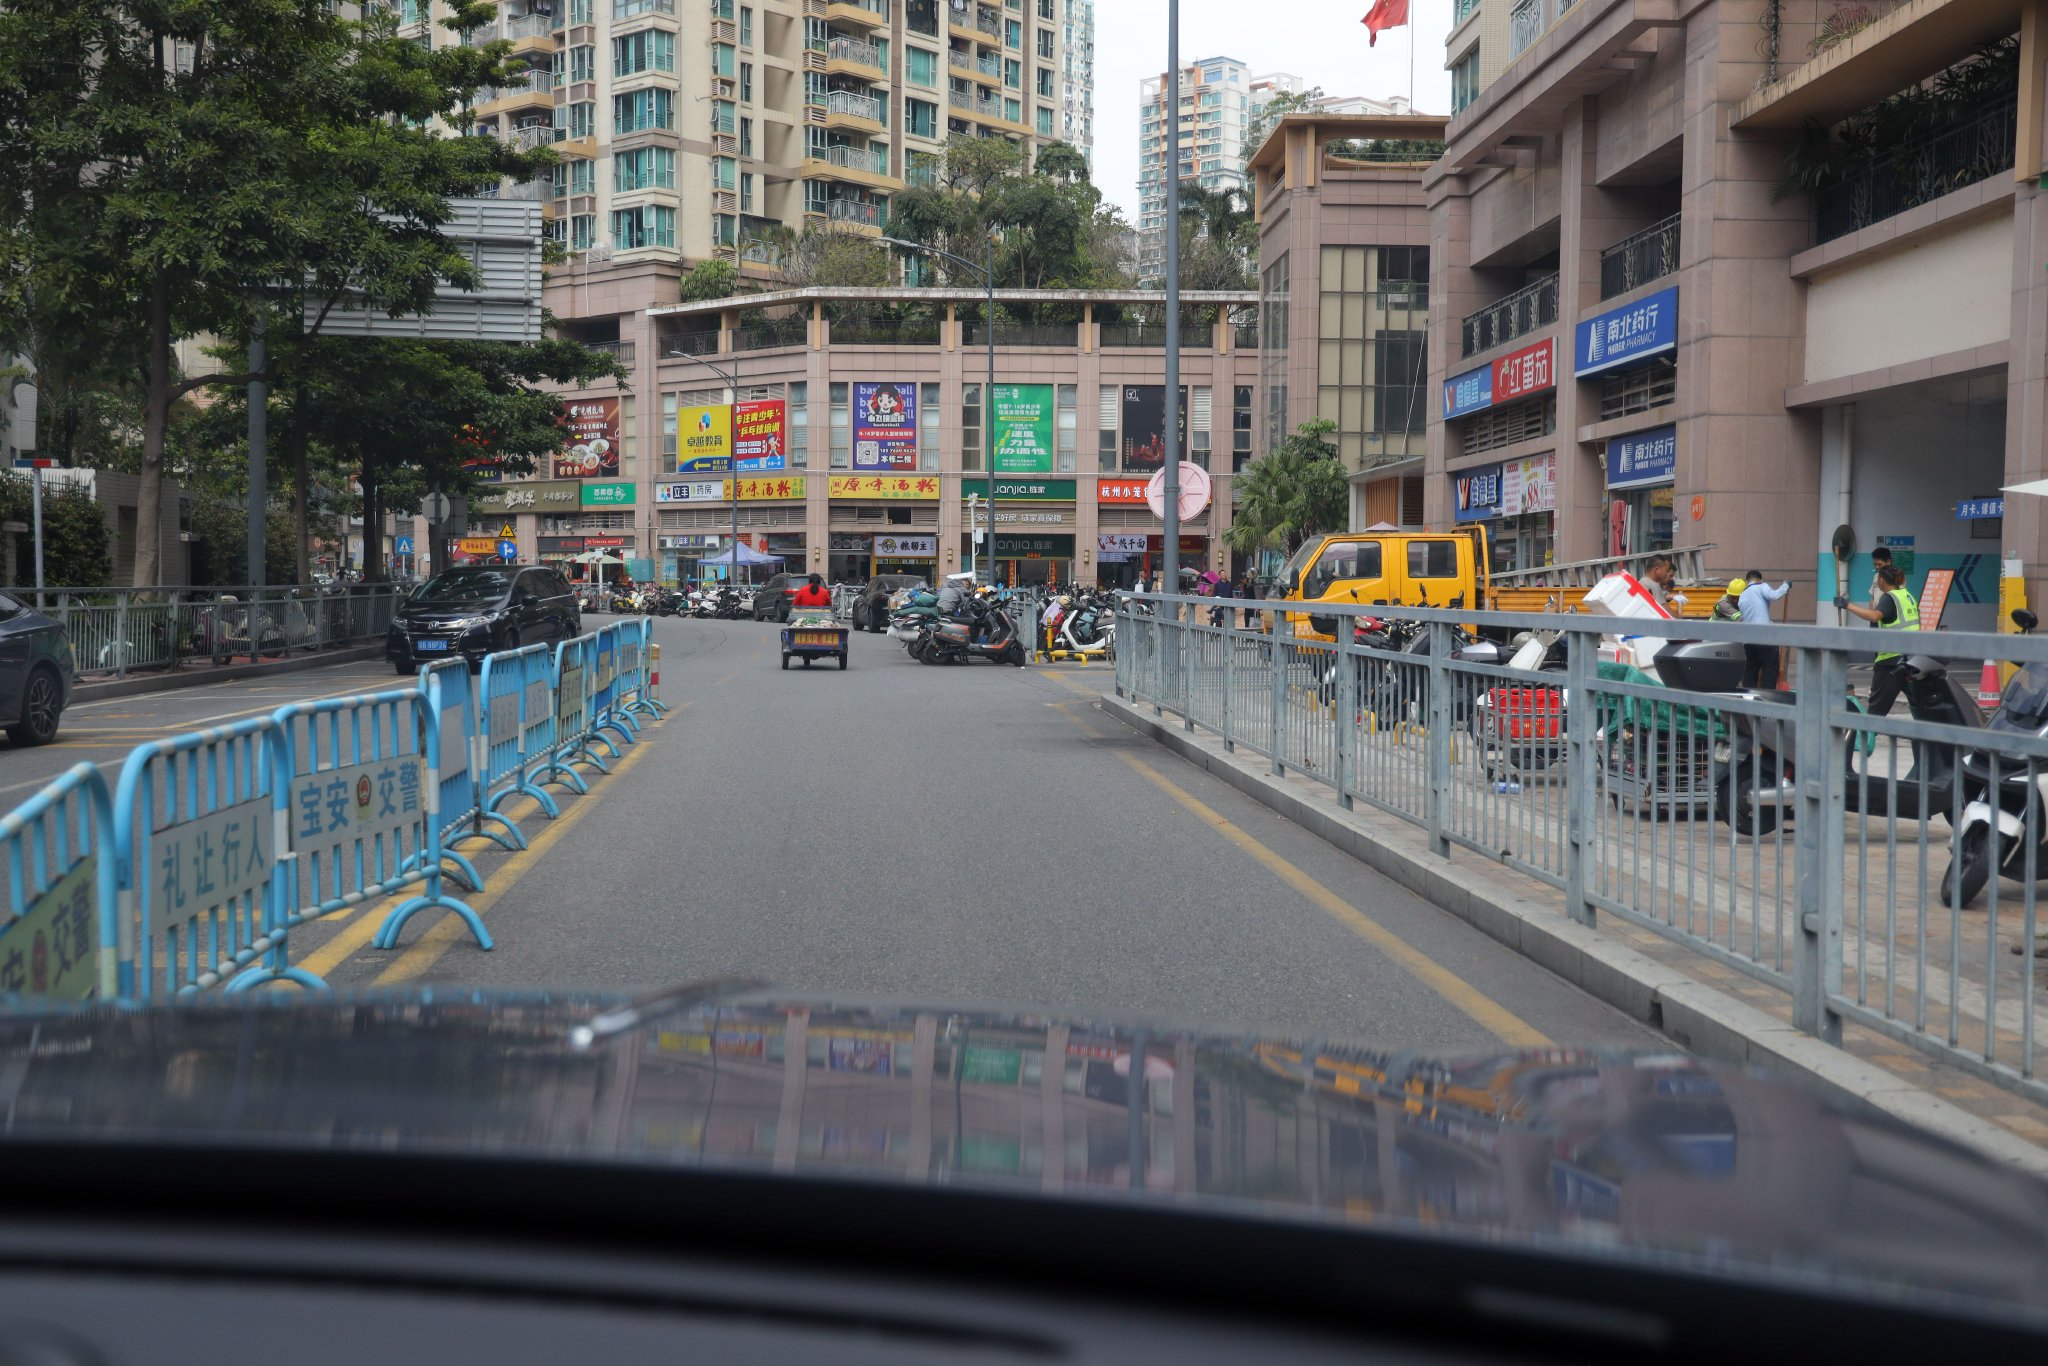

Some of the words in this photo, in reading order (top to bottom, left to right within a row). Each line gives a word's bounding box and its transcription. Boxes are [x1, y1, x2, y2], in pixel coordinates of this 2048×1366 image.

[1608, 303, 1659, 343] 南北药行
[1626, 330, 1657, 349] PHARMACY
[1510, 348, 1547, 394] 红番茄
[687, 435, 723, 447] 卓越教育
[1010, 439, 1037, 447] 力量
[1635, 437, 1675, 461] 南北药行
[999, 447, 1048, 455] 协调性
[674, 487, 689, 498] 立丰
[697, 484, 712, 495] 药房
[843, 478, 937, 492] 原味汤粉
[976, 513, 1017, 522] 安买好房
[300, 776, 350, 838] 宝安
[377, 761, 418, 819] 交警
[161, 815, 265, 914] 礼让行人
[52, 879, 90, 987] 交警
